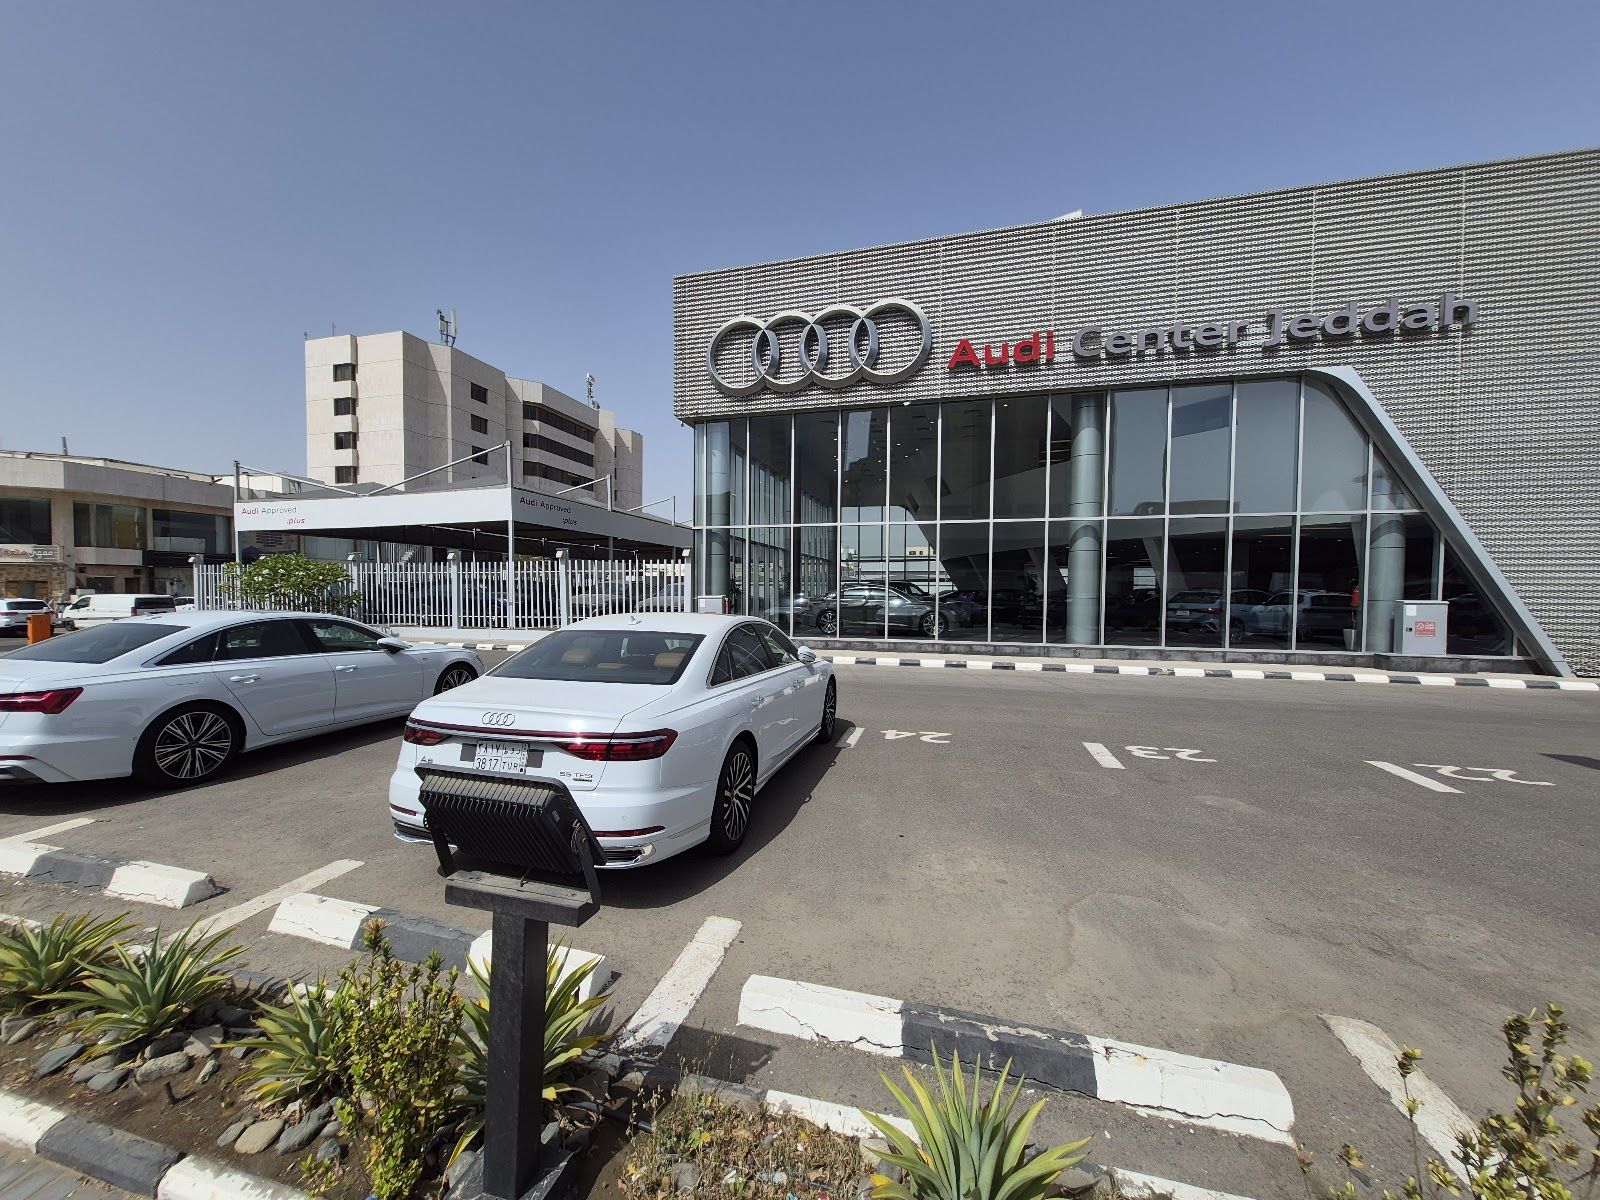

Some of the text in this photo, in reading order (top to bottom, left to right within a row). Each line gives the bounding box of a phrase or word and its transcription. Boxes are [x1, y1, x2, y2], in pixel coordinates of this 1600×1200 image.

[946, 292, 1480, 369] Audi Center Jeddah
[241, 506, 297, 516] Audi Approved
[519, 496, 571, 513] Audi Approved
[879, 729, 953, 743] 24
[1124, 745, 1218, 762] 23
[476, 757, 499, 770] 3817
[1411, 763, 1557, 786] 22
